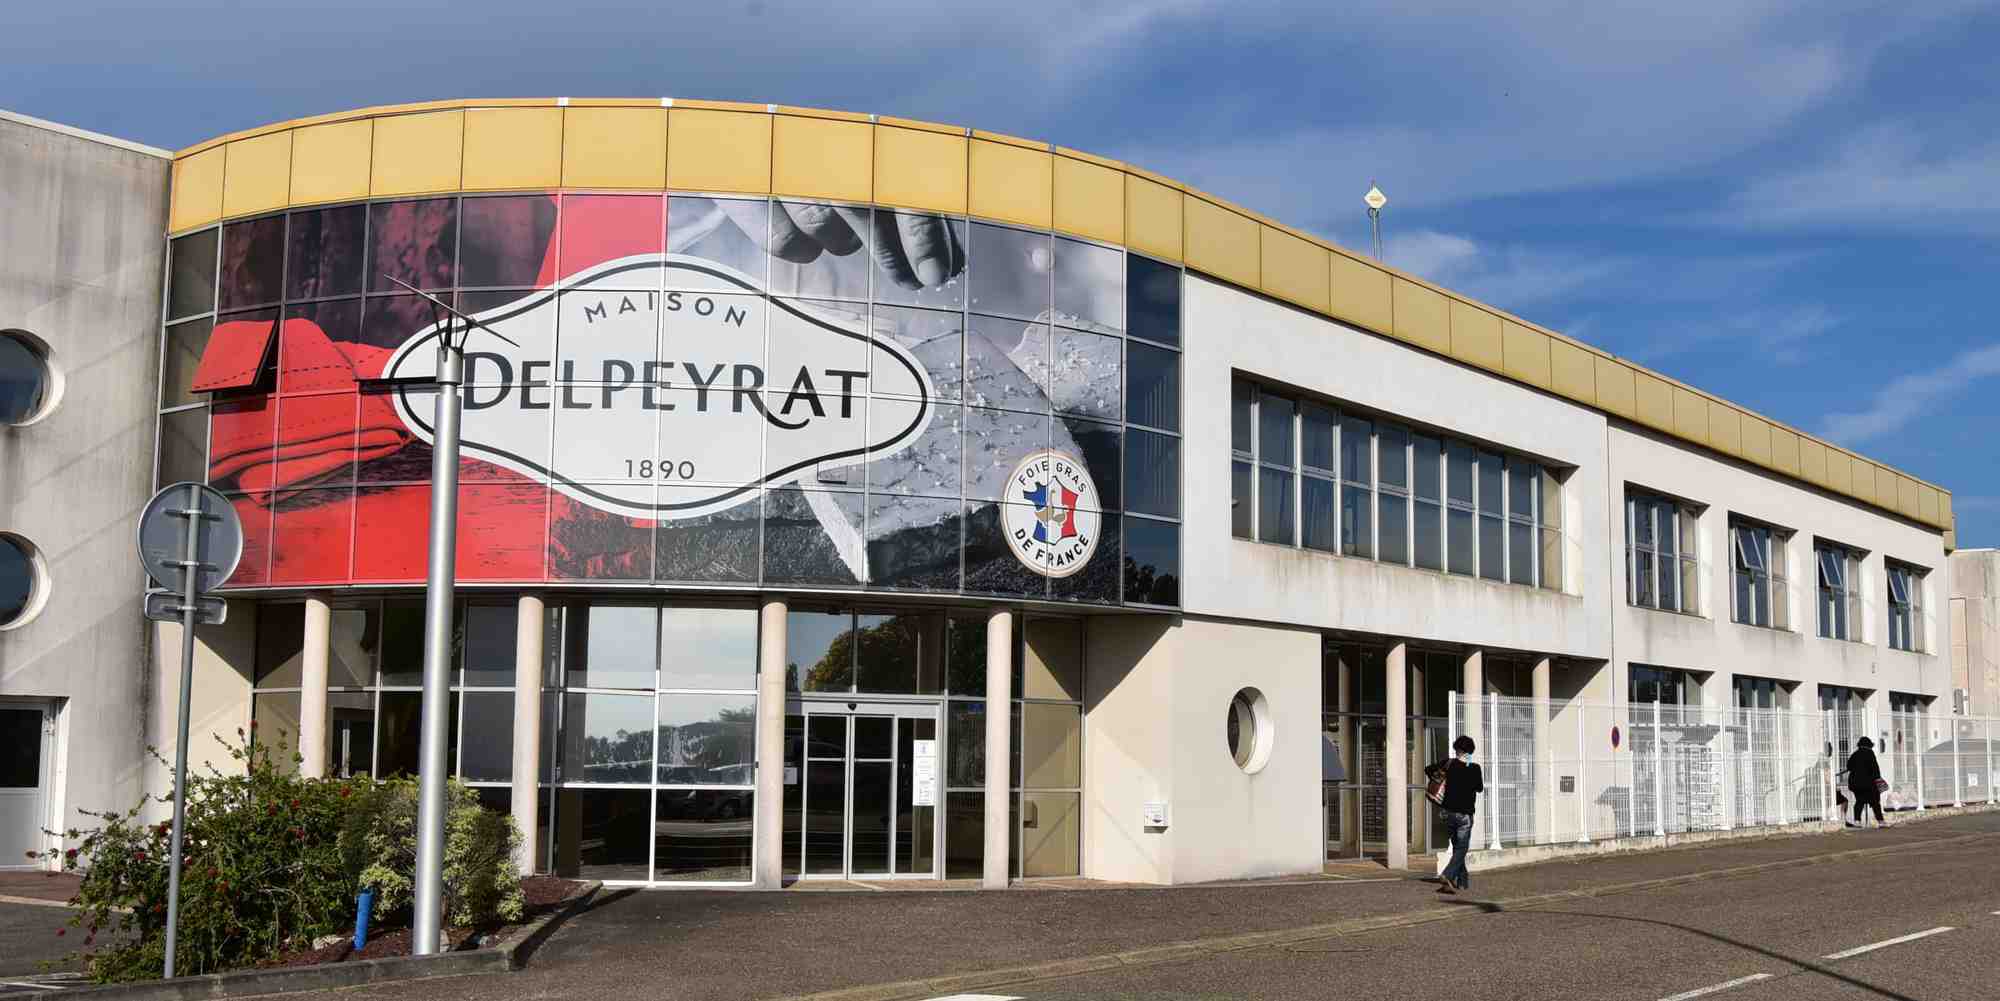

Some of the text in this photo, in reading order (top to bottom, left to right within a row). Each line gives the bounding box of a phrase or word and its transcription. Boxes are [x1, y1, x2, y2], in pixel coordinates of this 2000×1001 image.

[584, 292, 747, 328] MAISON
[463, 351, 869, 429] DELPEYRAT
[624, 459, 695, 481] 1890
[1018, 460, 1087, 493] FOIE GRAS
[1014, 528, 1089, 567] DE FRANCE
